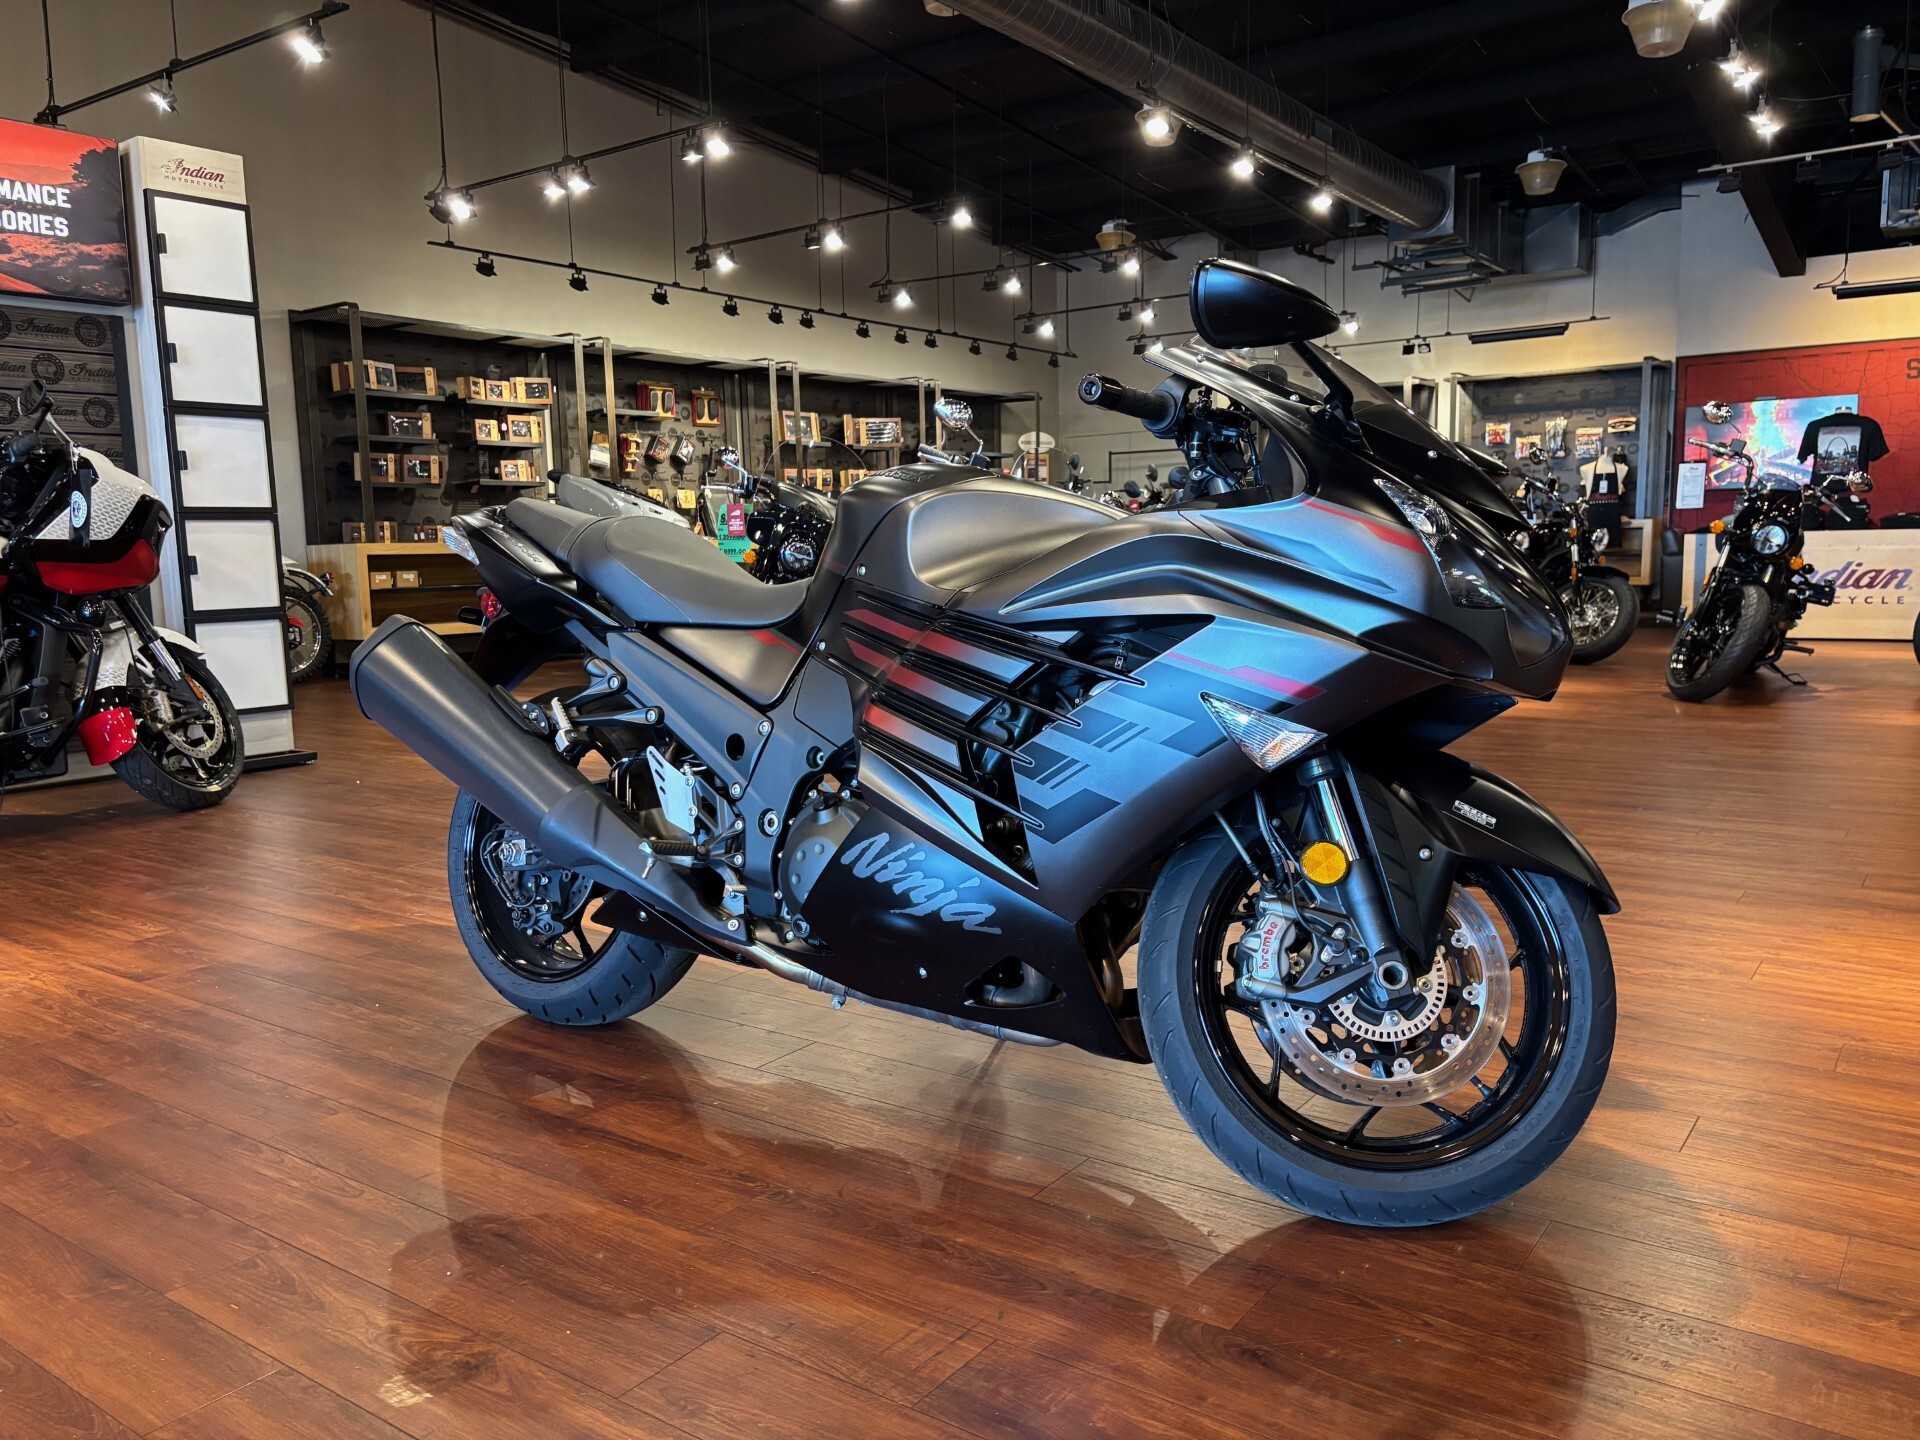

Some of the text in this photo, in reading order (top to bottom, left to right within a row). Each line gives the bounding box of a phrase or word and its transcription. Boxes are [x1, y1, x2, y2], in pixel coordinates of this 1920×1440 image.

[164, 158, 225, 183] Indian
[164, 175, 224, 190] MOTORCYCLE
[0, 209, 70, 238] ORIES
[840, 832, 1002, 935] Ninja
[1258, 921, 1279, 970] brembo
